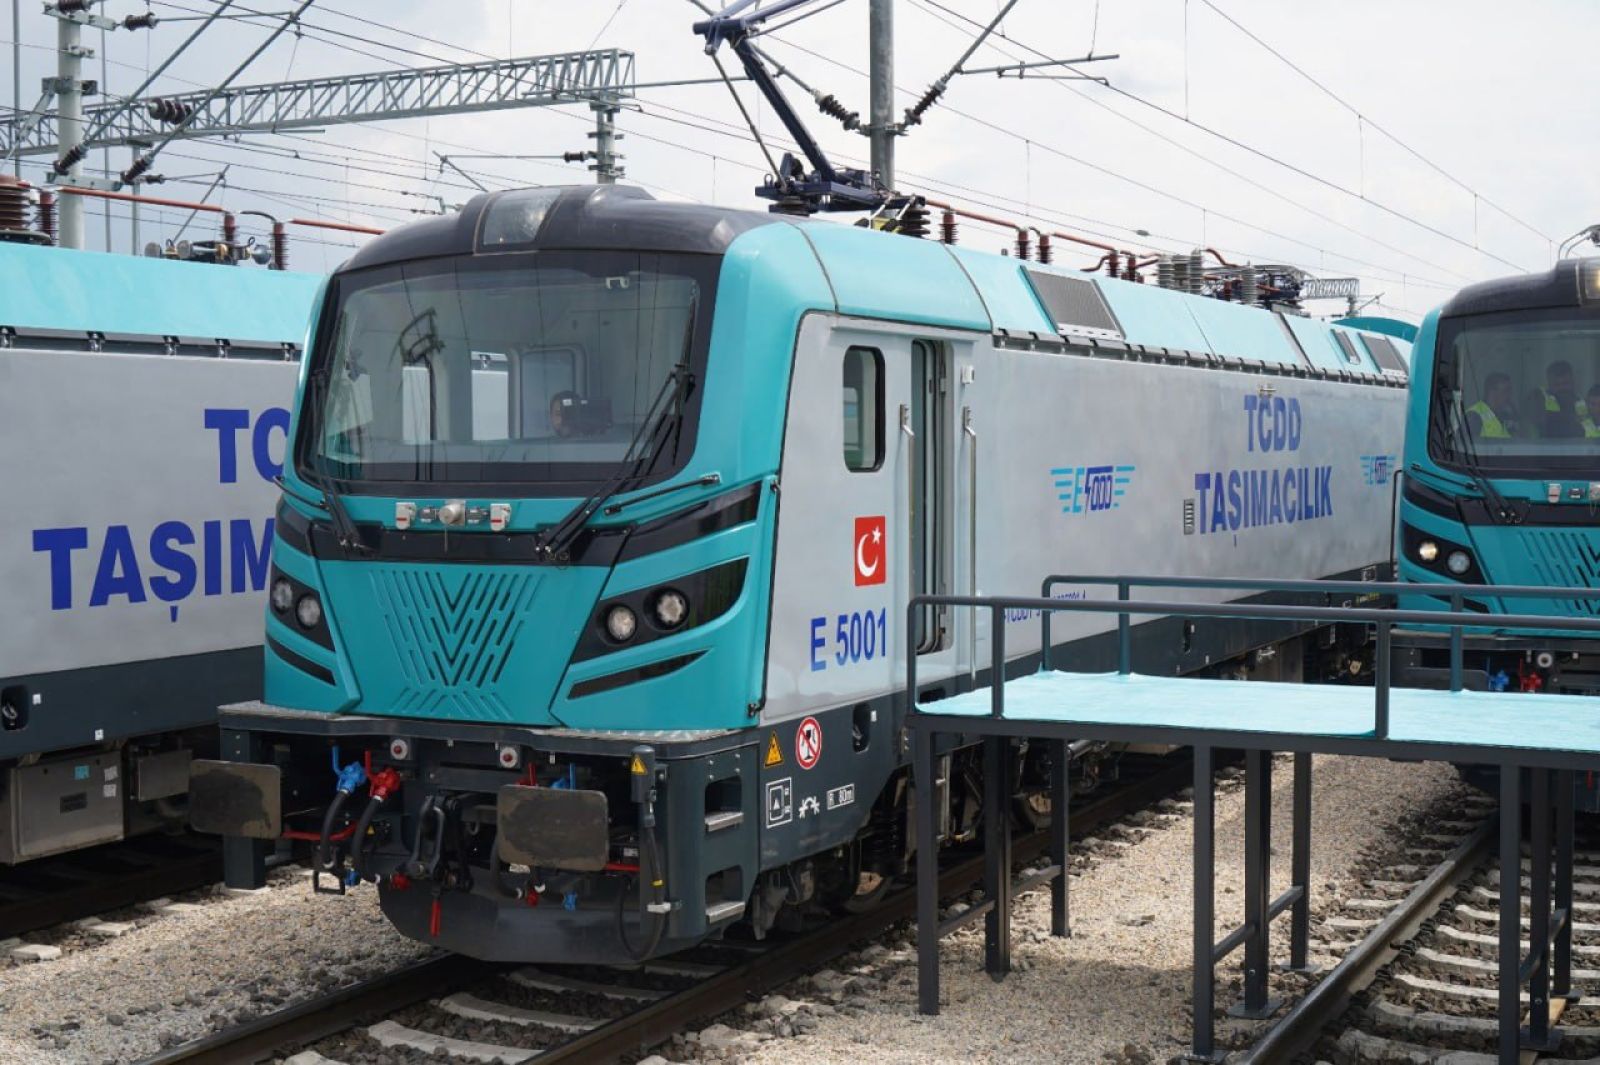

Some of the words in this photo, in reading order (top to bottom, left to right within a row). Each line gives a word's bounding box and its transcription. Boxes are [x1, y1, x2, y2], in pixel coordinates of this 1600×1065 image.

[1244, 394, 1302, 453] TCDD
[1194, 465, 1333, 548] TAŞIMACILIK
[811, 617, 826, 672] E
[836, 607, 886, 666] 5001
